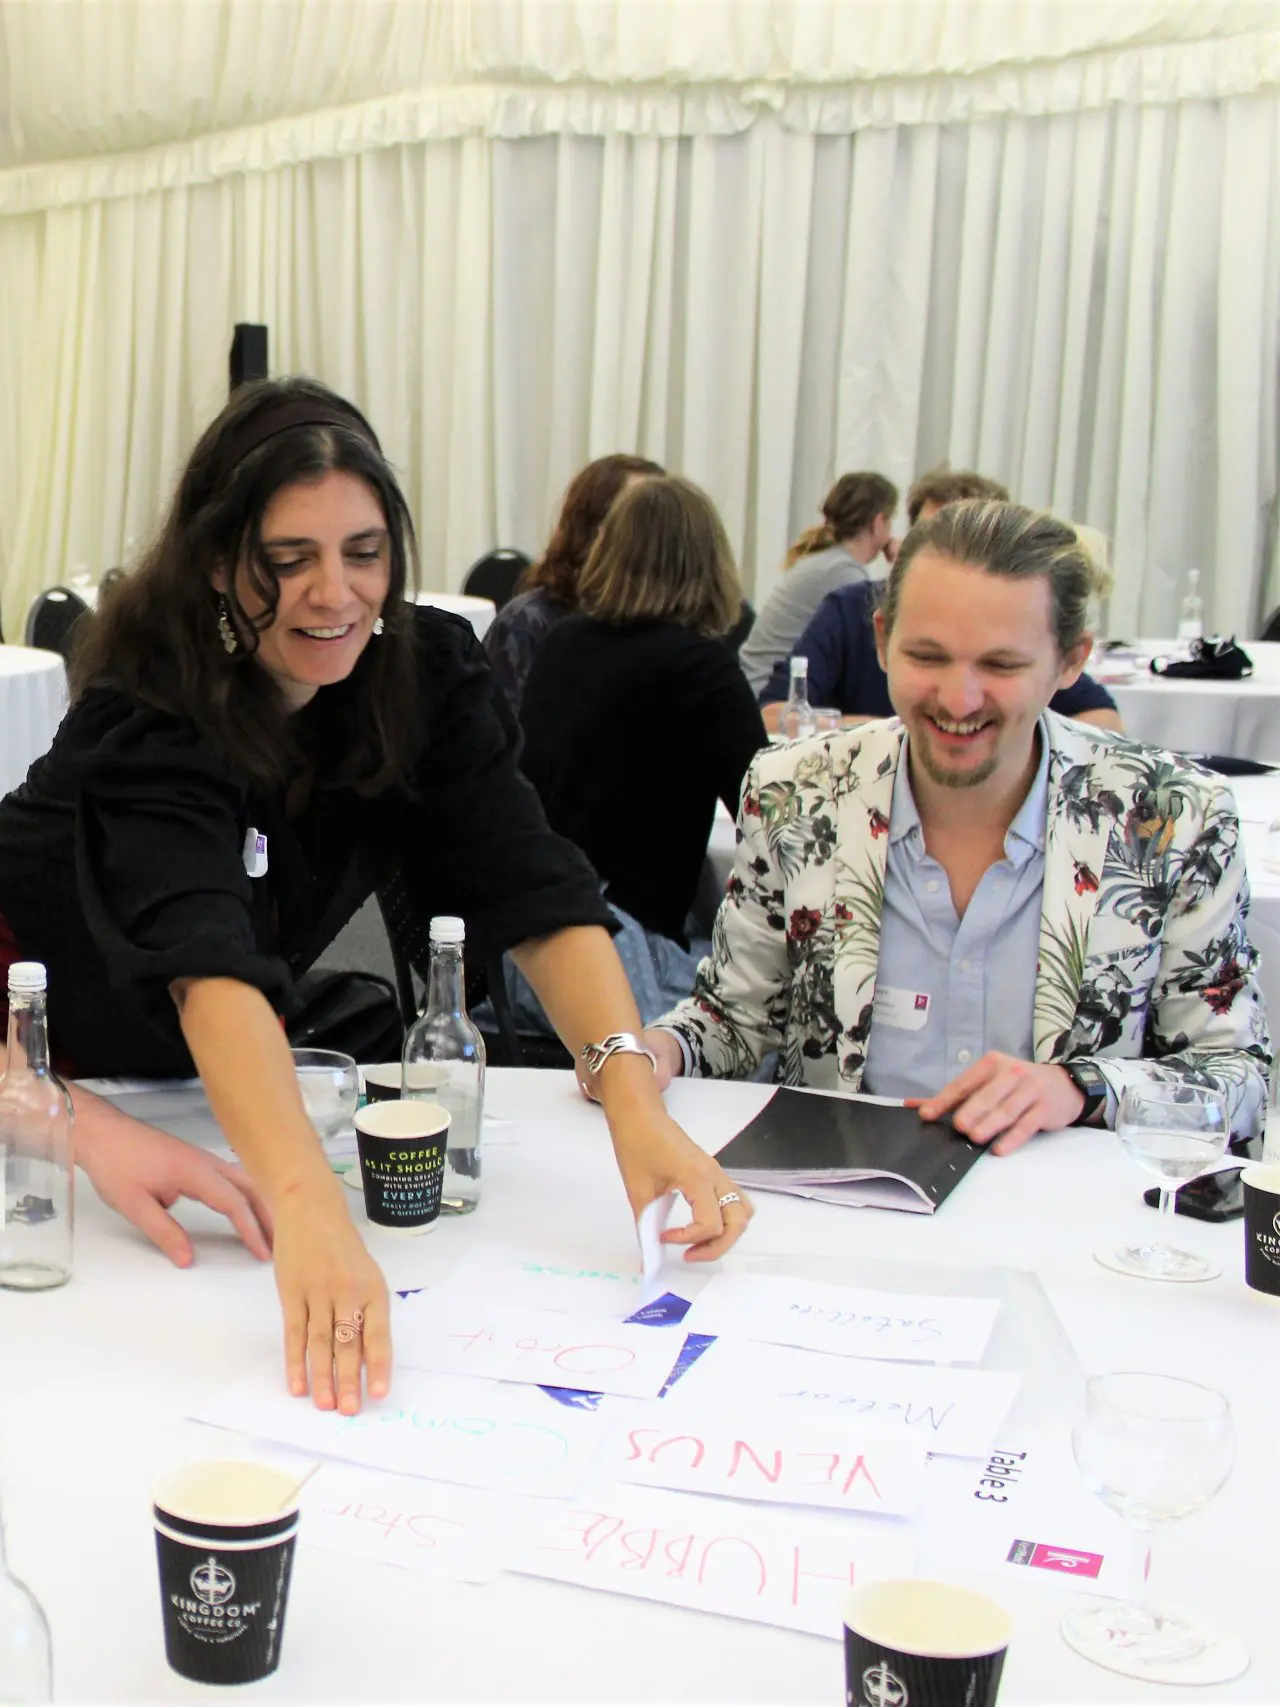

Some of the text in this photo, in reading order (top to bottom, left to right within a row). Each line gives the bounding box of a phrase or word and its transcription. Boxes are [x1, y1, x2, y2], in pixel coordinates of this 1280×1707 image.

[389, 1147, 439, 1161] COFFEE
[364, 1159, 377, 1169] AS
[380, 1163, 392, 1173] IT
[396, 1157, 443, 1173] SHOULD
[371, 1172, 412, 1182] COMBINING
[383, 1181, 402, 1190] WITH
[383, 1186, 440, 1201] EVERY SIP
[449, 1326, 637, 1376] Orbit
[626, 1426, 882, 1499] VENUS
[974, 1450, 1027, 1504] Table 3
[318, 1501, 467, 1551] Star
[170, 1593, 258, 1618] KINGDOM
[182, 1612, 224, 1629] COFFEE
